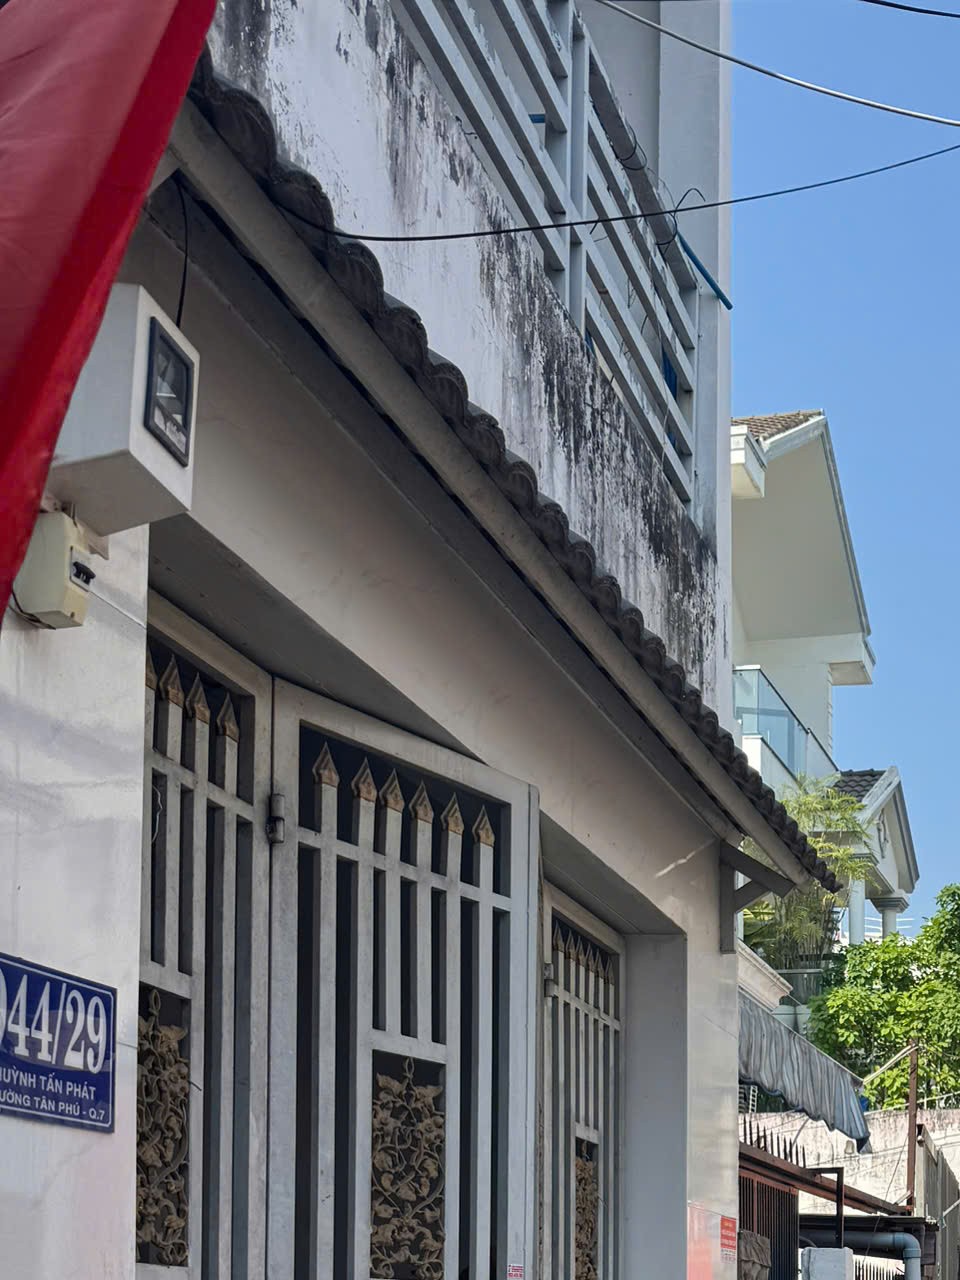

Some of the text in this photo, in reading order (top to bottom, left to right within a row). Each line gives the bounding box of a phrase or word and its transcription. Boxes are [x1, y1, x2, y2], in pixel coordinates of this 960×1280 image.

[0, 1065, 97, 1100] UỲNH TẤN PHÁT
[33, 1095, 55, 1111] TÂN
[58, 1102, 80, 1116] PHÚ
[88, 1108, 105, 1121] Q.7
